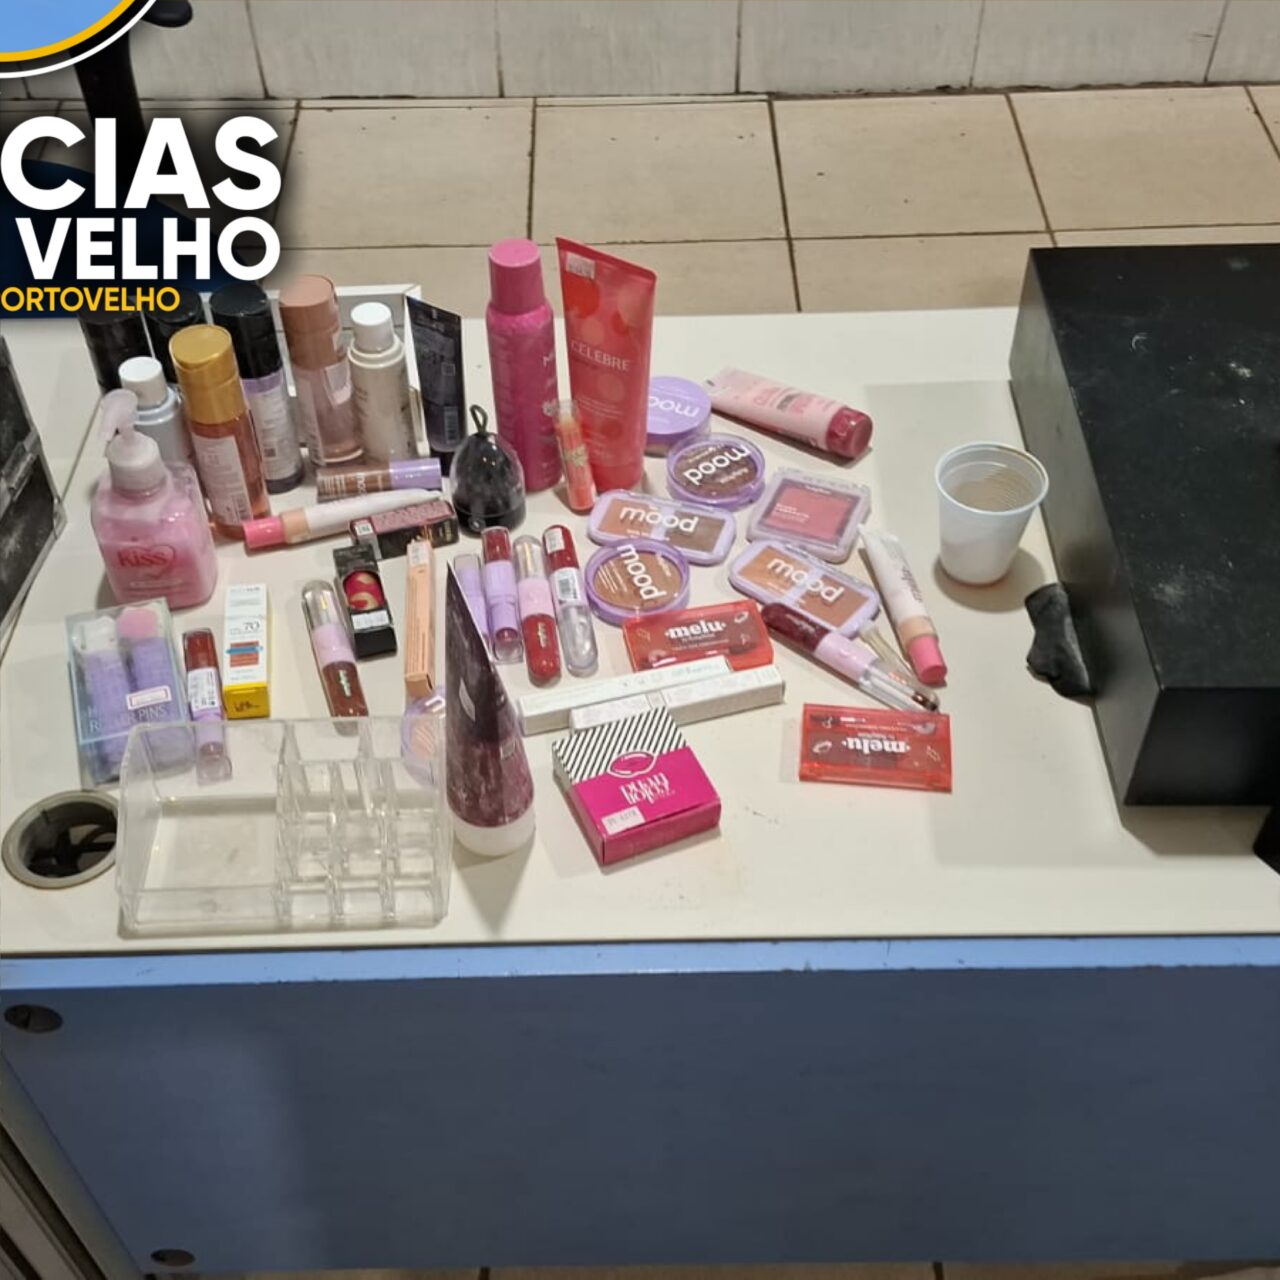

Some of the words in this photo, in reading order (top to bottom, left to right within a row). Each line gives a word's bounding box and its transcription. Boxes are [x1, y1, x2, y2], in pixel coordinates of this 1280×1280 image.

[570, 340, 631, 372] CELEBRE
[683, 443, 752, 486] mood
[619, 506, 700, 533] mood
[616, 543, 668, 601] mood
[766, 557, 846, 603] mood
[669, 619, 724, 640] melu
[845, 736, 908, 755] melu
